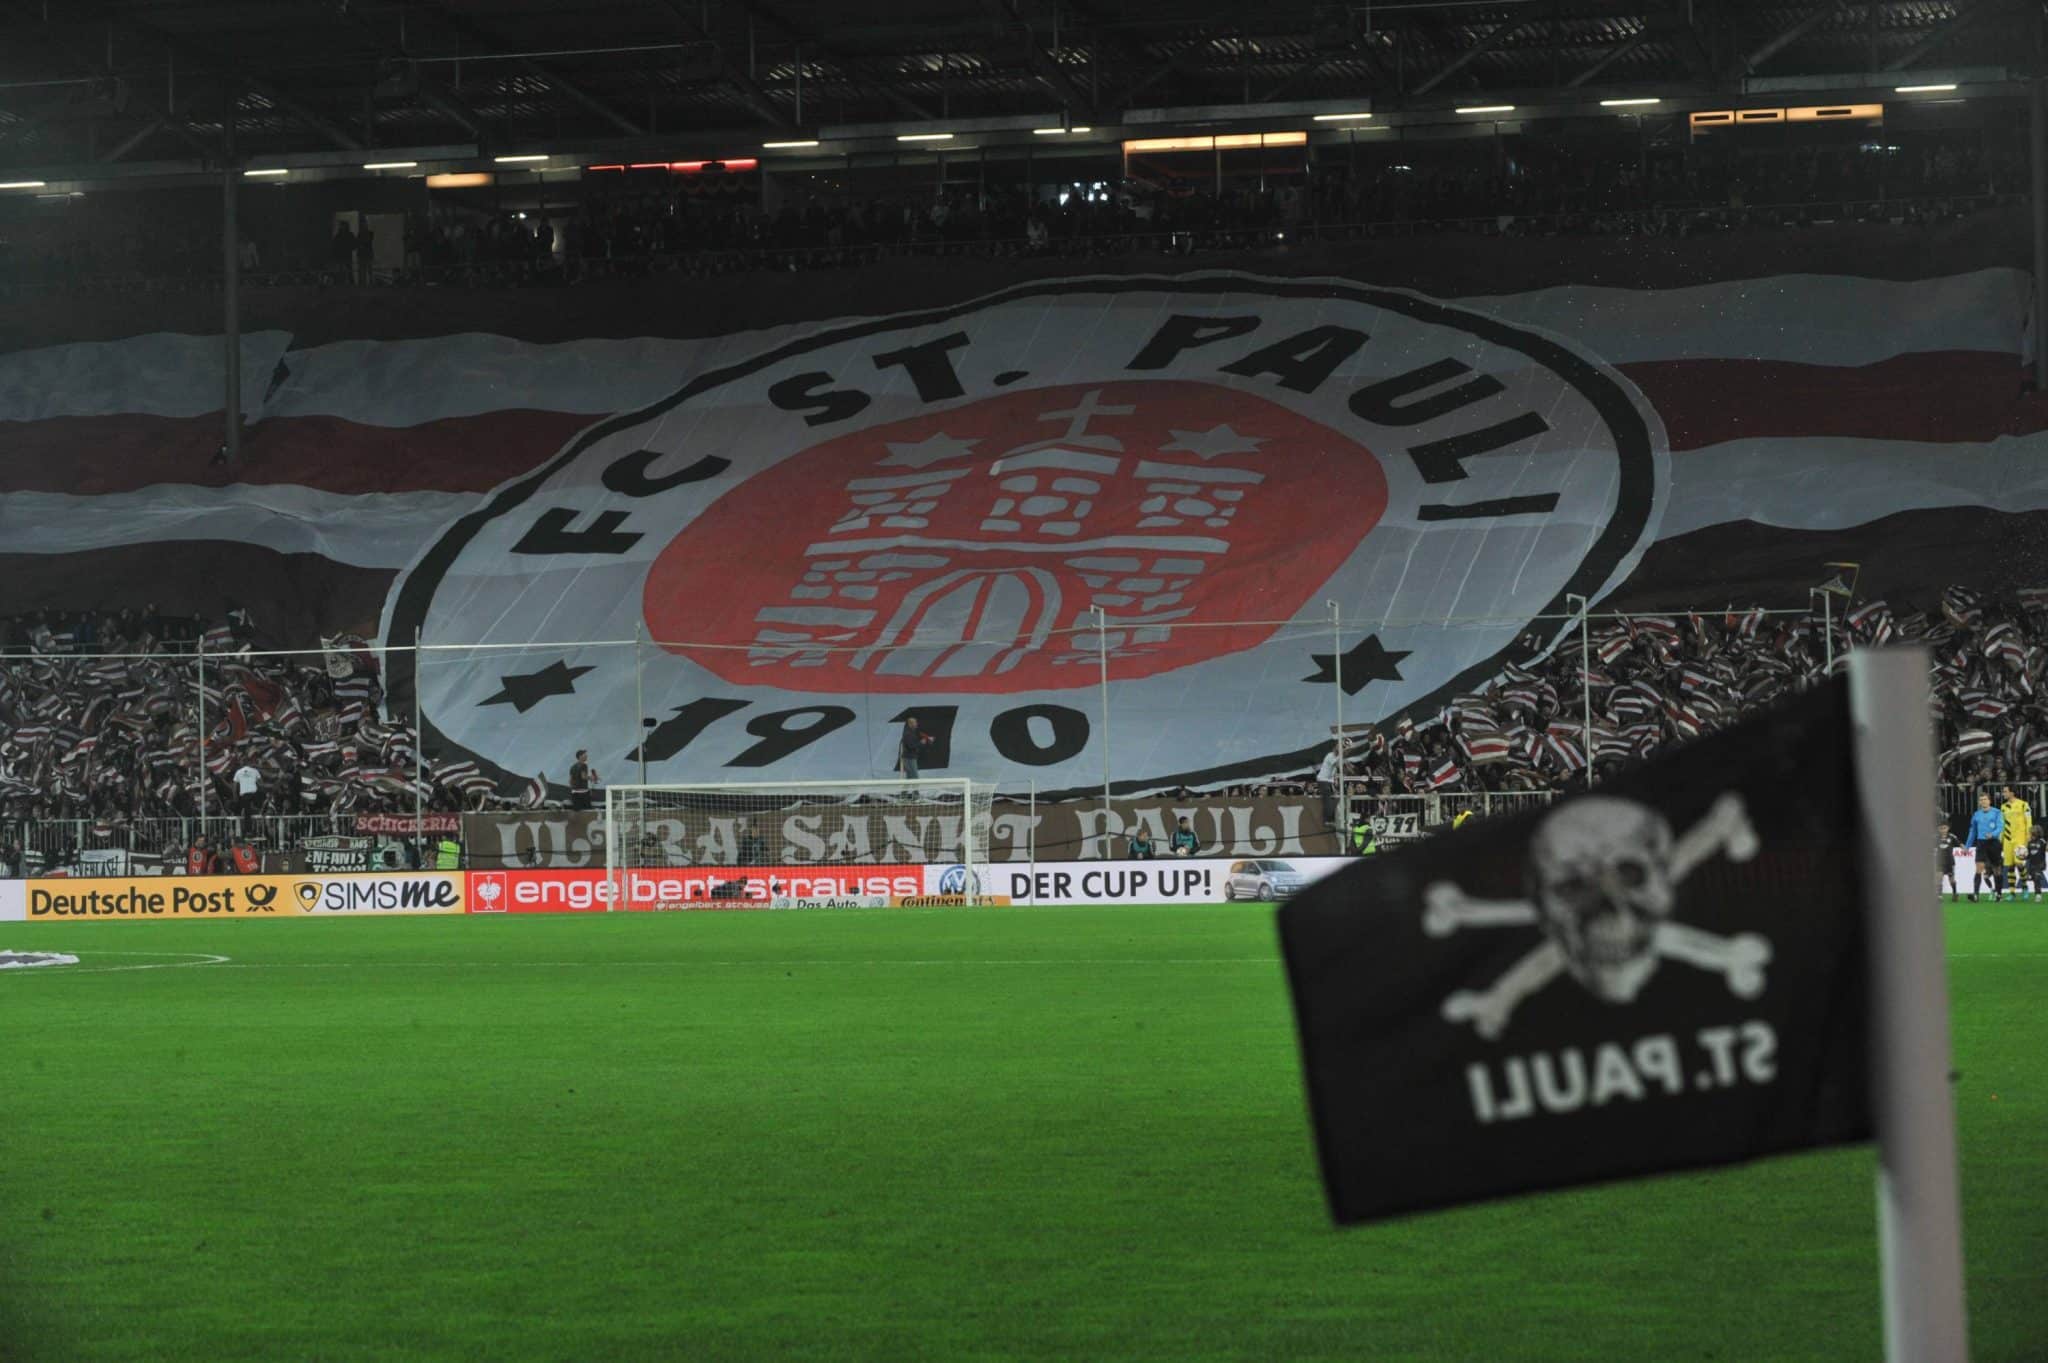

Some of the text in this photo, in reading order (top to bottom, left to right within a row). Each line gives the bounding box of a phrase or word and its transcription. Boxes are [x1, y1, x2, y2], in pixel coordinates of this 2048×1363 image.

[509, 314, 1560, 555] FC ST. PAULI
[625, 696, 1090, 772] 1910
[782, 814, 1042, 864] SANKT
[1076, 804, 1304, 860] PAULI
[31, 886, 235, 915] Deutsche Post
[514, 873, 918, 909] engelbert strauss
[1011, 868, 1211, 899] DER CUP UP!
[797, 899, 816, 909] Das
